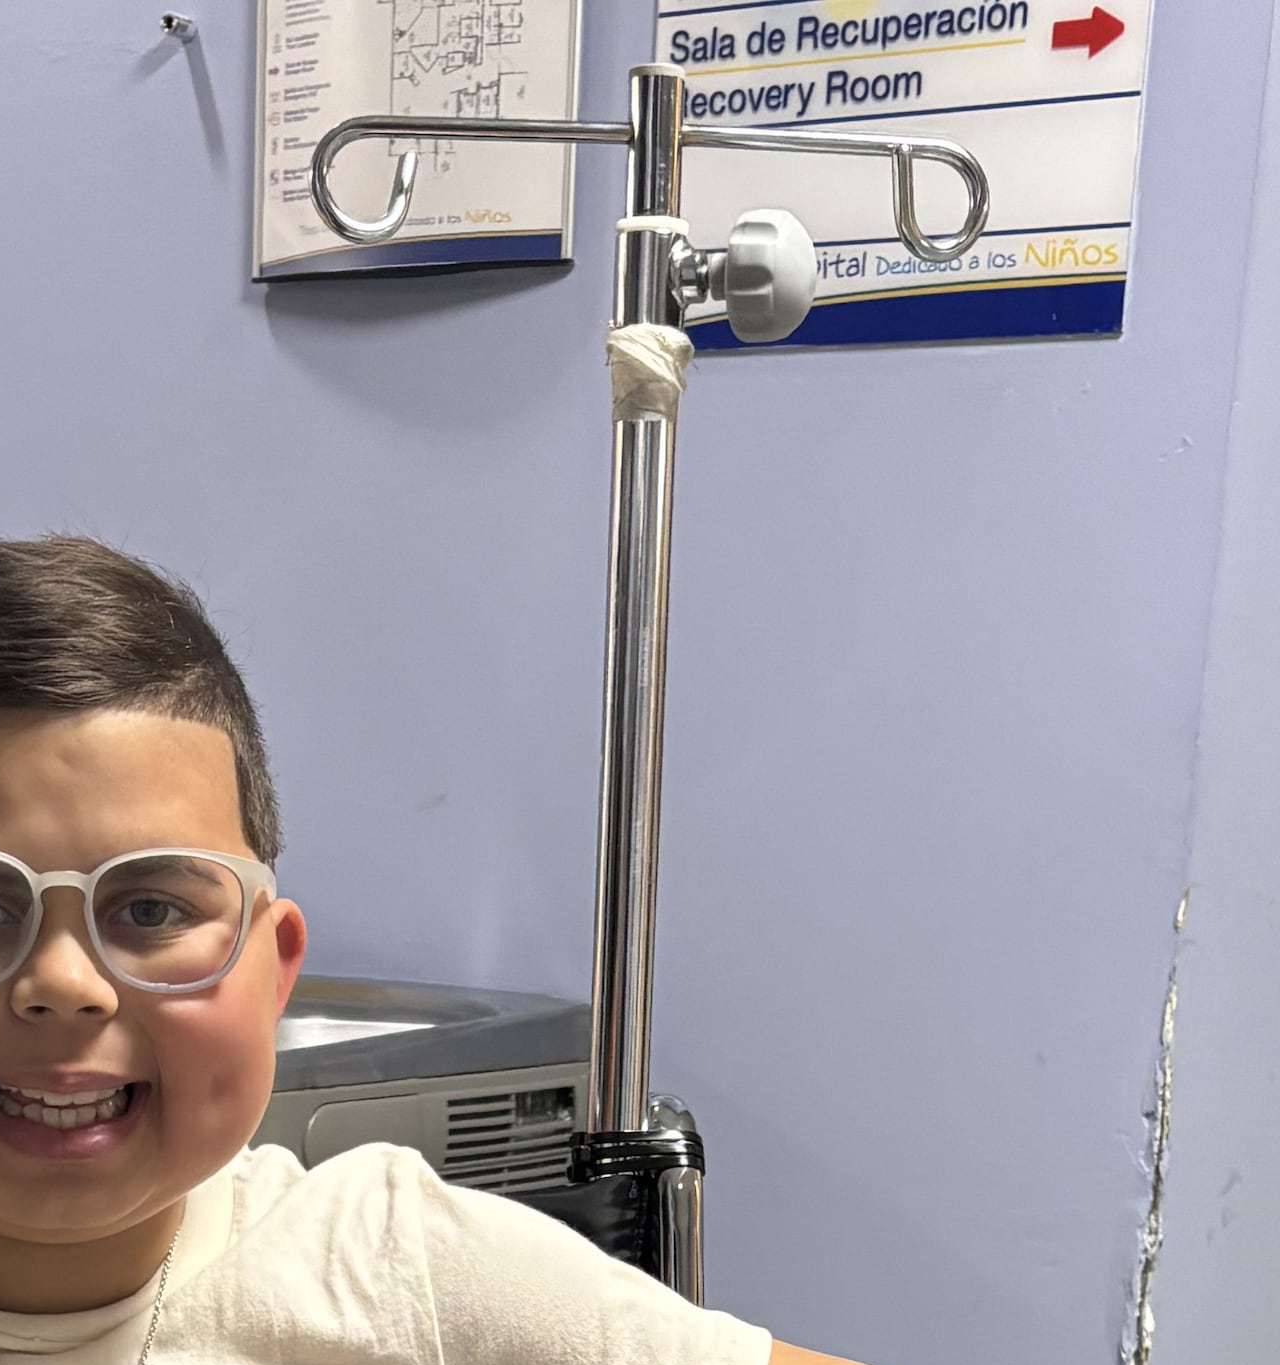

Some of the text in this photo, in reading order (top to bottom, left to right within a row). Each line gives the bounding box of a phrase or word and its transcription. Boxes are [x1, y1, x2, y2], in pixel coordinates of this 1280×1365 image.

[669, 27, 736, 64] Sala
[746, 22, 786, 58] de
[684, 69, 923, 118] ecovery Room
[816, 250, 868, 280] ital
[968, 255, 980, 270] a
[986, 251, 1017, 270] los
[1023, 236, 1119, 269] Niños
